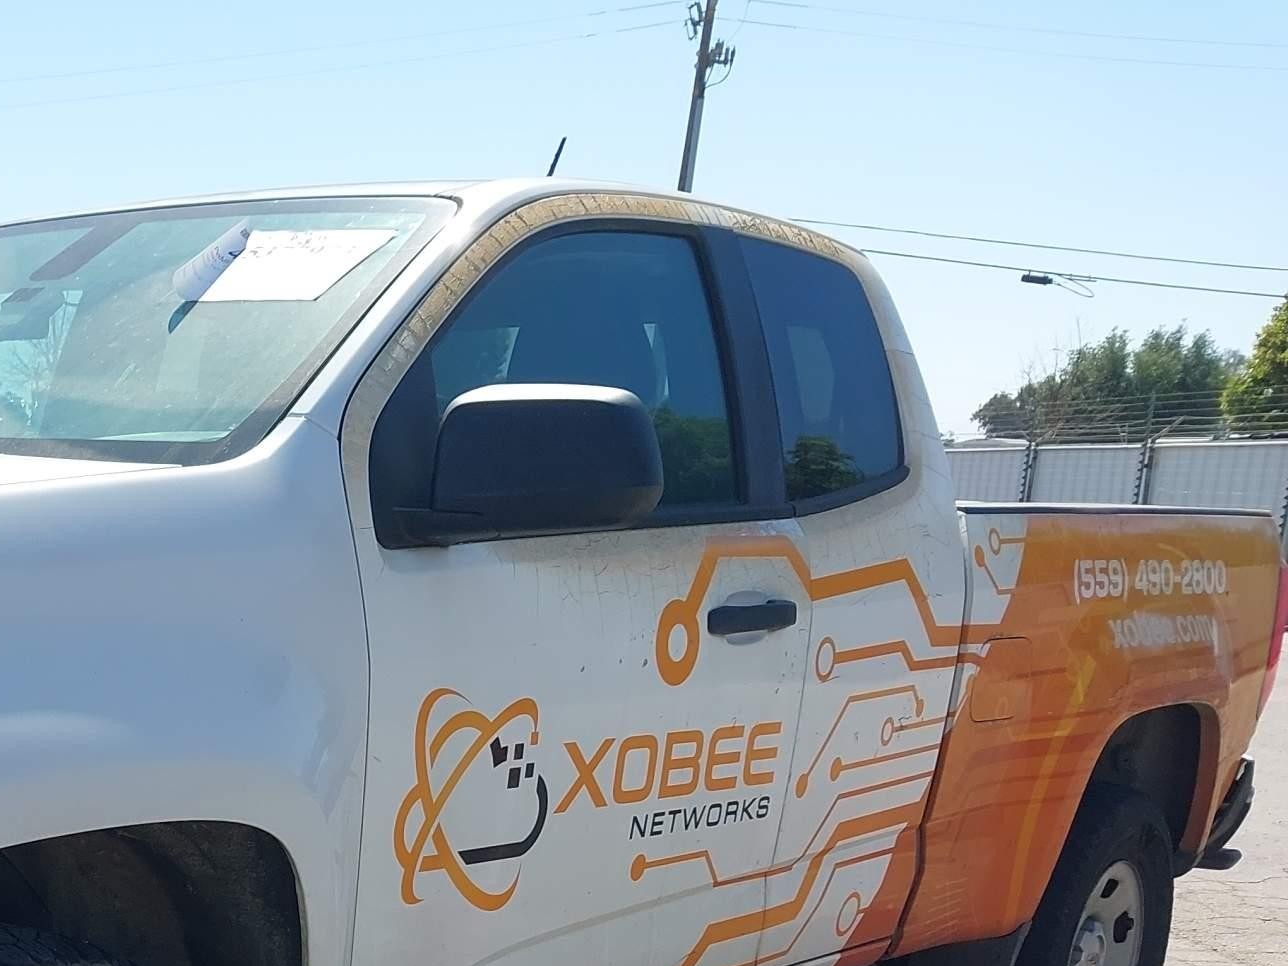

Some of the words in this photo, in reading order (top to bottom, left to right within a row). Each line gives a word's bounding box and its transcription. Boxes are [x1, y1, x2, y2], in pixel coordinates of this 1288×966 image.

[1074, 558, 1128, 605] (559)
[1134, 559, 1227, 595] 490-2800
[552, 721, 783, 815] XOBEE
[629, 795, 771, 840] NETWORKS
